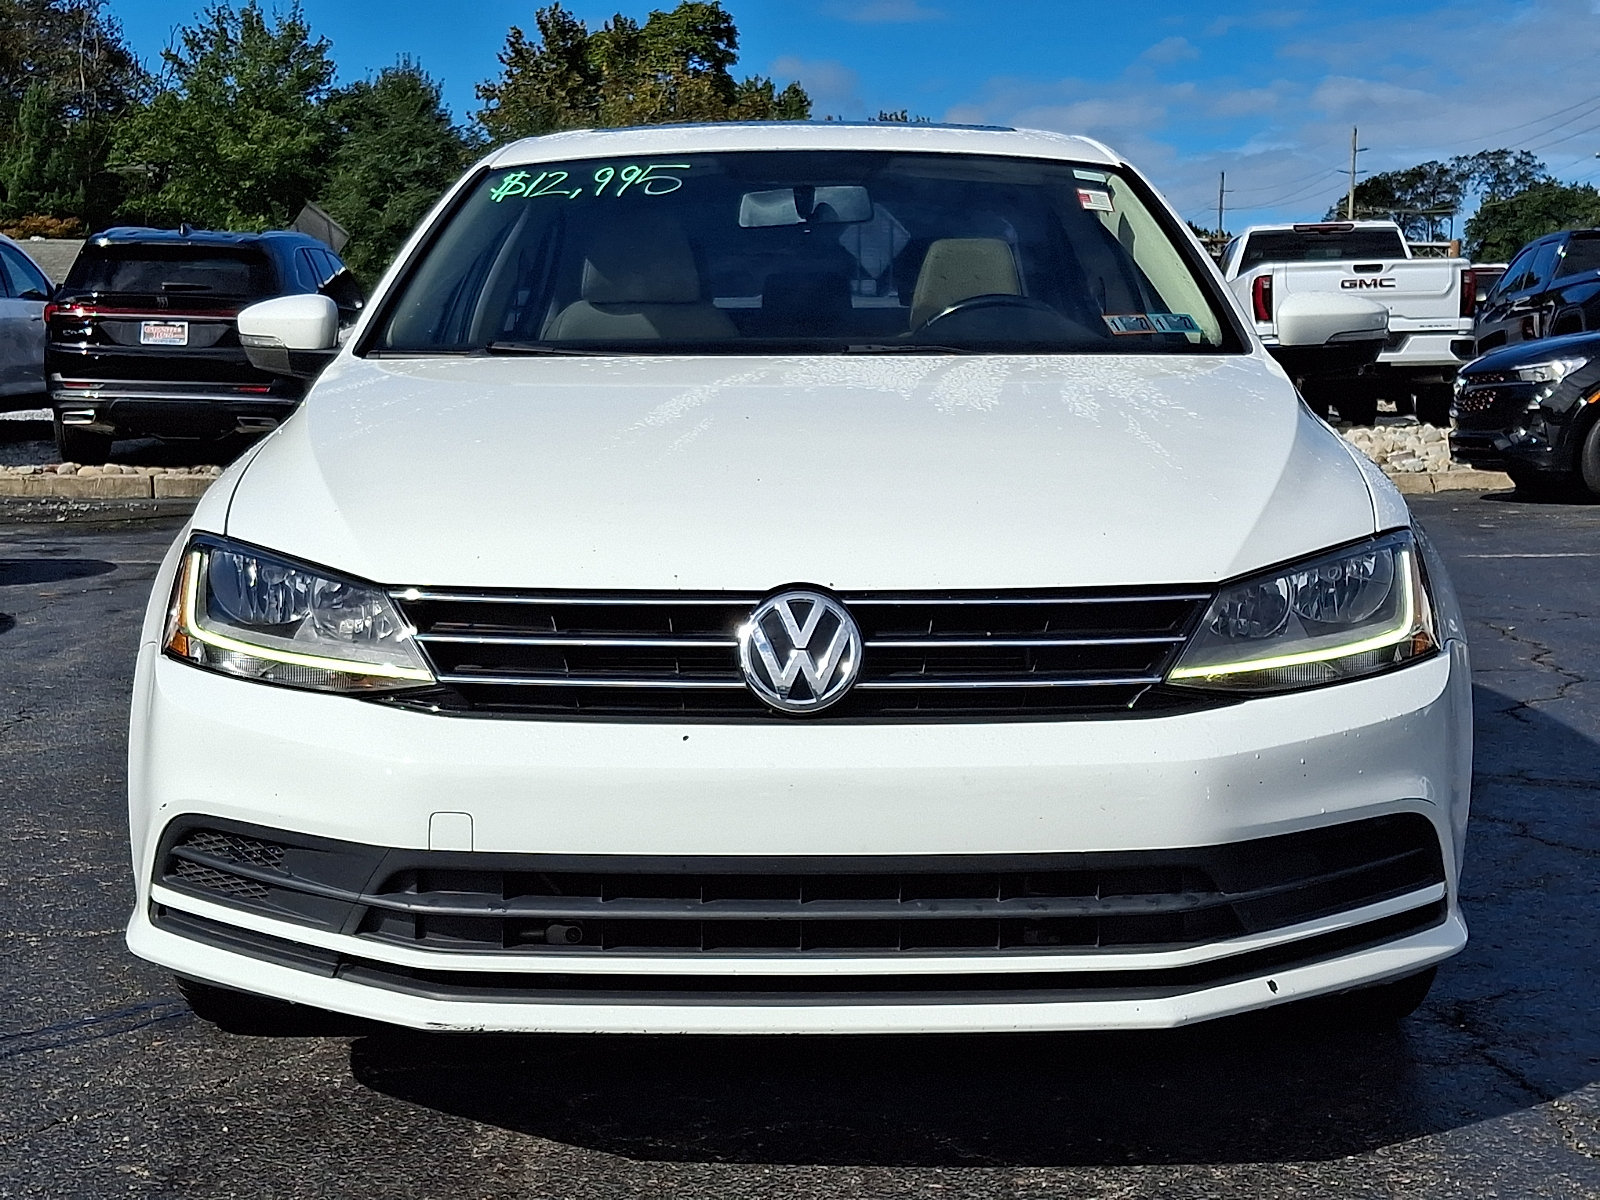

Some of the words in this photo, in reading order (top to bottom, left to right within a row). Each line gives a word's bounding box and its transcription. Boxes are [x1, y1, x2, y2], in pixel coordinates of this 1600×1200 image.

[490, 164, 690, 202] $12,995
[1341, 278, 1396, 289] GMC
[749, 596, 853, 702] VW
